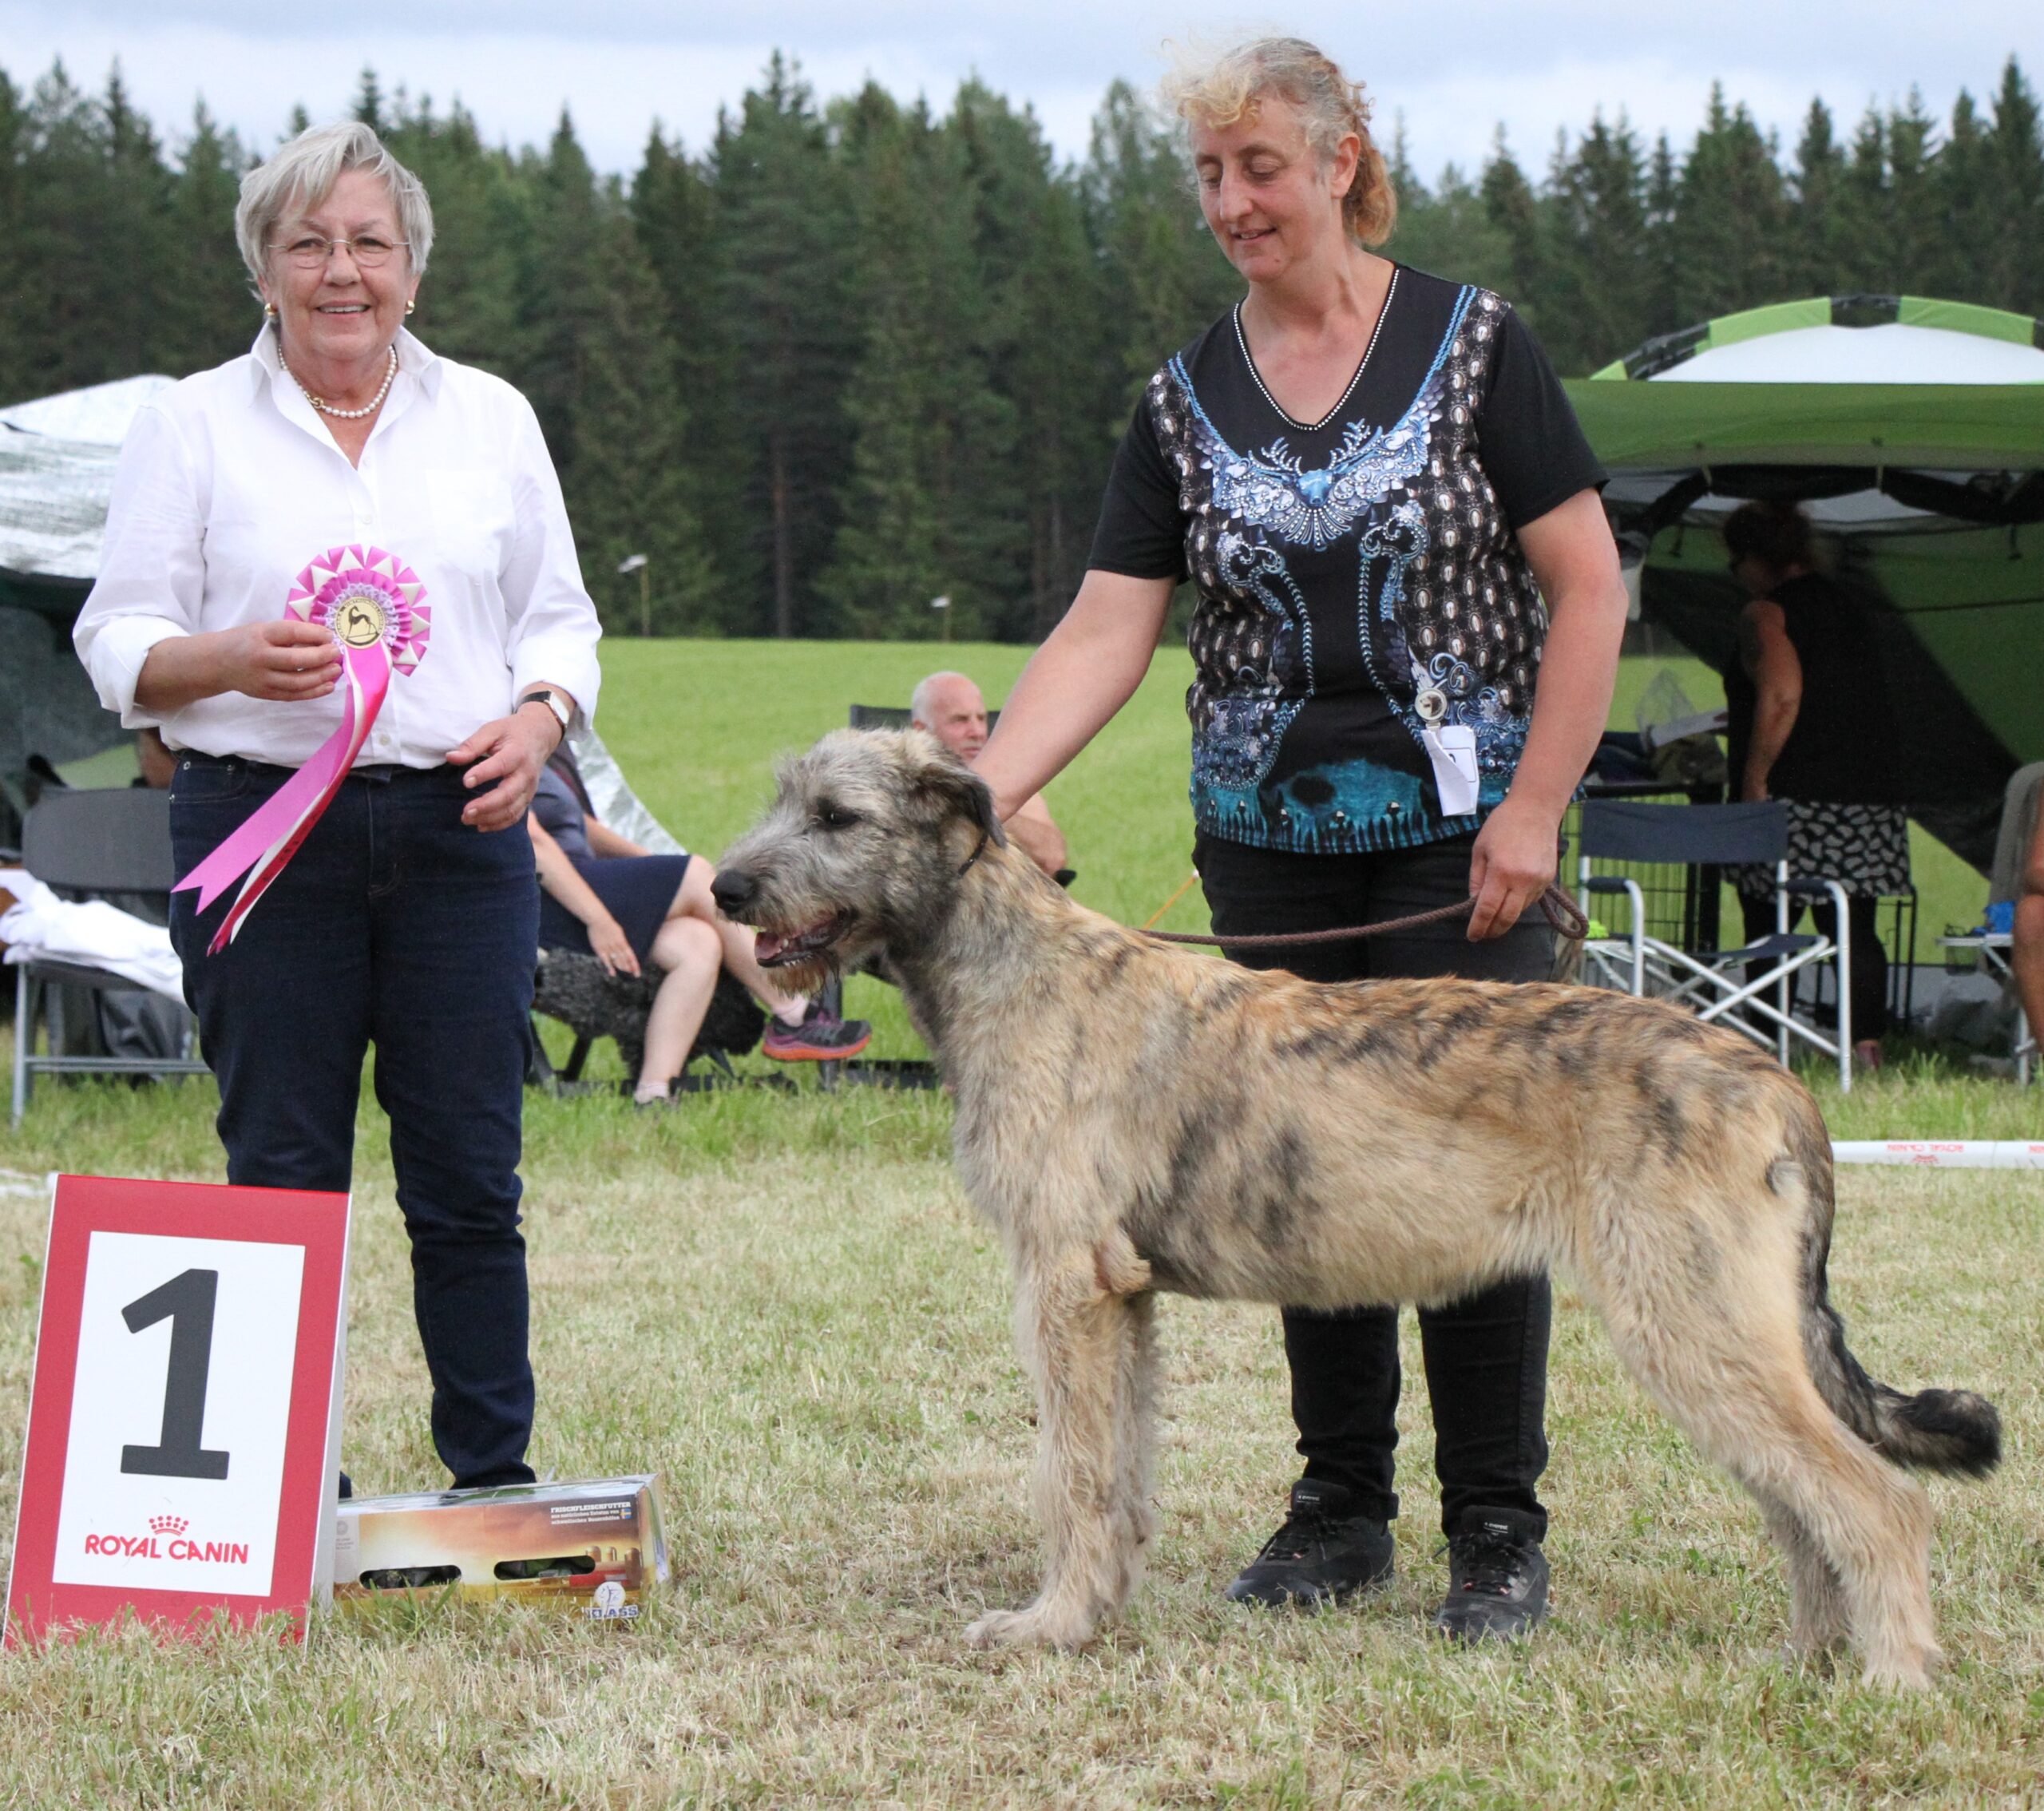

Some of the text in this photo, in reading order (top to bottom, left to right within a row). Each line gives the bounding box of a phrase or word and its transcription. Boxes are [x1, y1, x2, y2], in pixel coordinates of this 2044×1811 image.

[121, 1268, 230, 1480] 1
[85, 1534, 249, 1564] ROYAL CANIN
